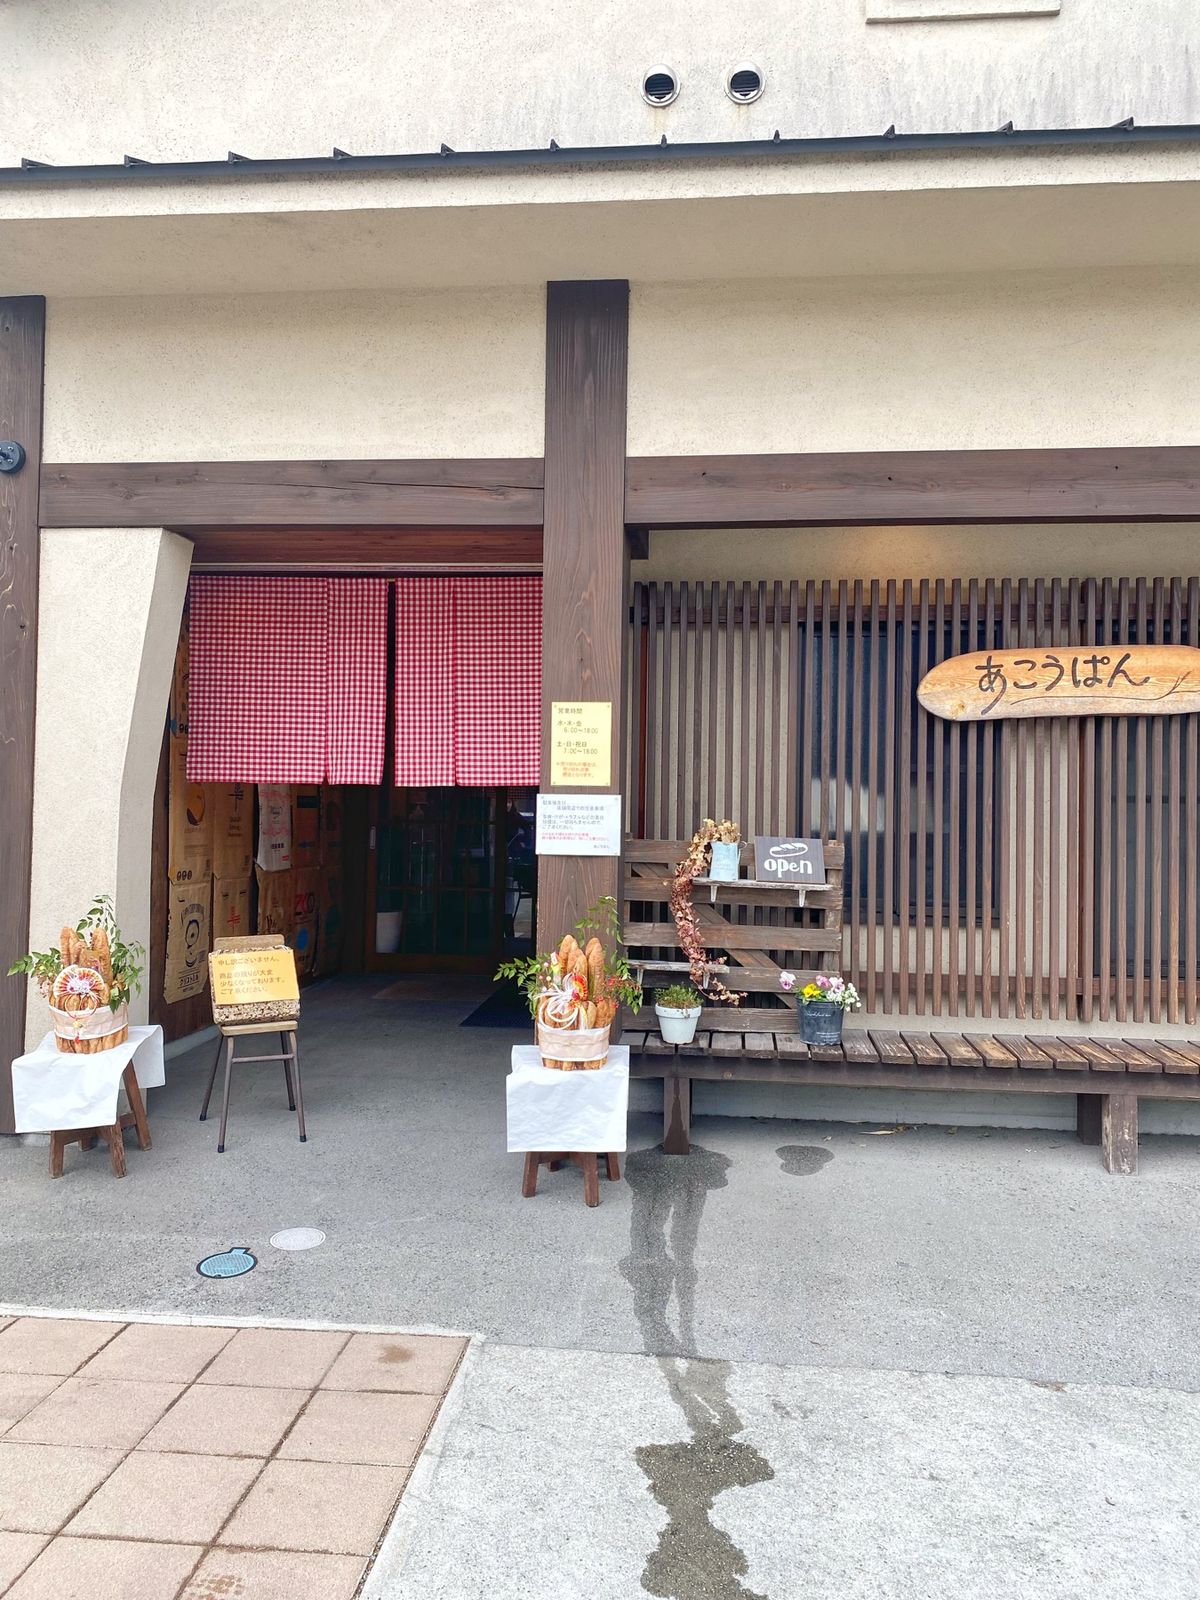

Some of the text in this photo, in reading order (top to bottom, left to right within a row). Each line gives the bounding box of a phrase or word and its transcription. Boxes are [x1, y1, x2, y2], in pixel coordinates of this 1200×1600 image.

[975, 653, 1150, 715] あこうぱん
[764, 858, 813, 878] open
[218, 956, 280, 966] 申し訳ございません。
[219, 969, 273, 979] 商品の残りが大変
[219, 977, 285, 987] 少なくなっております。
[220, 987, 268, 995] ご了承ください。
